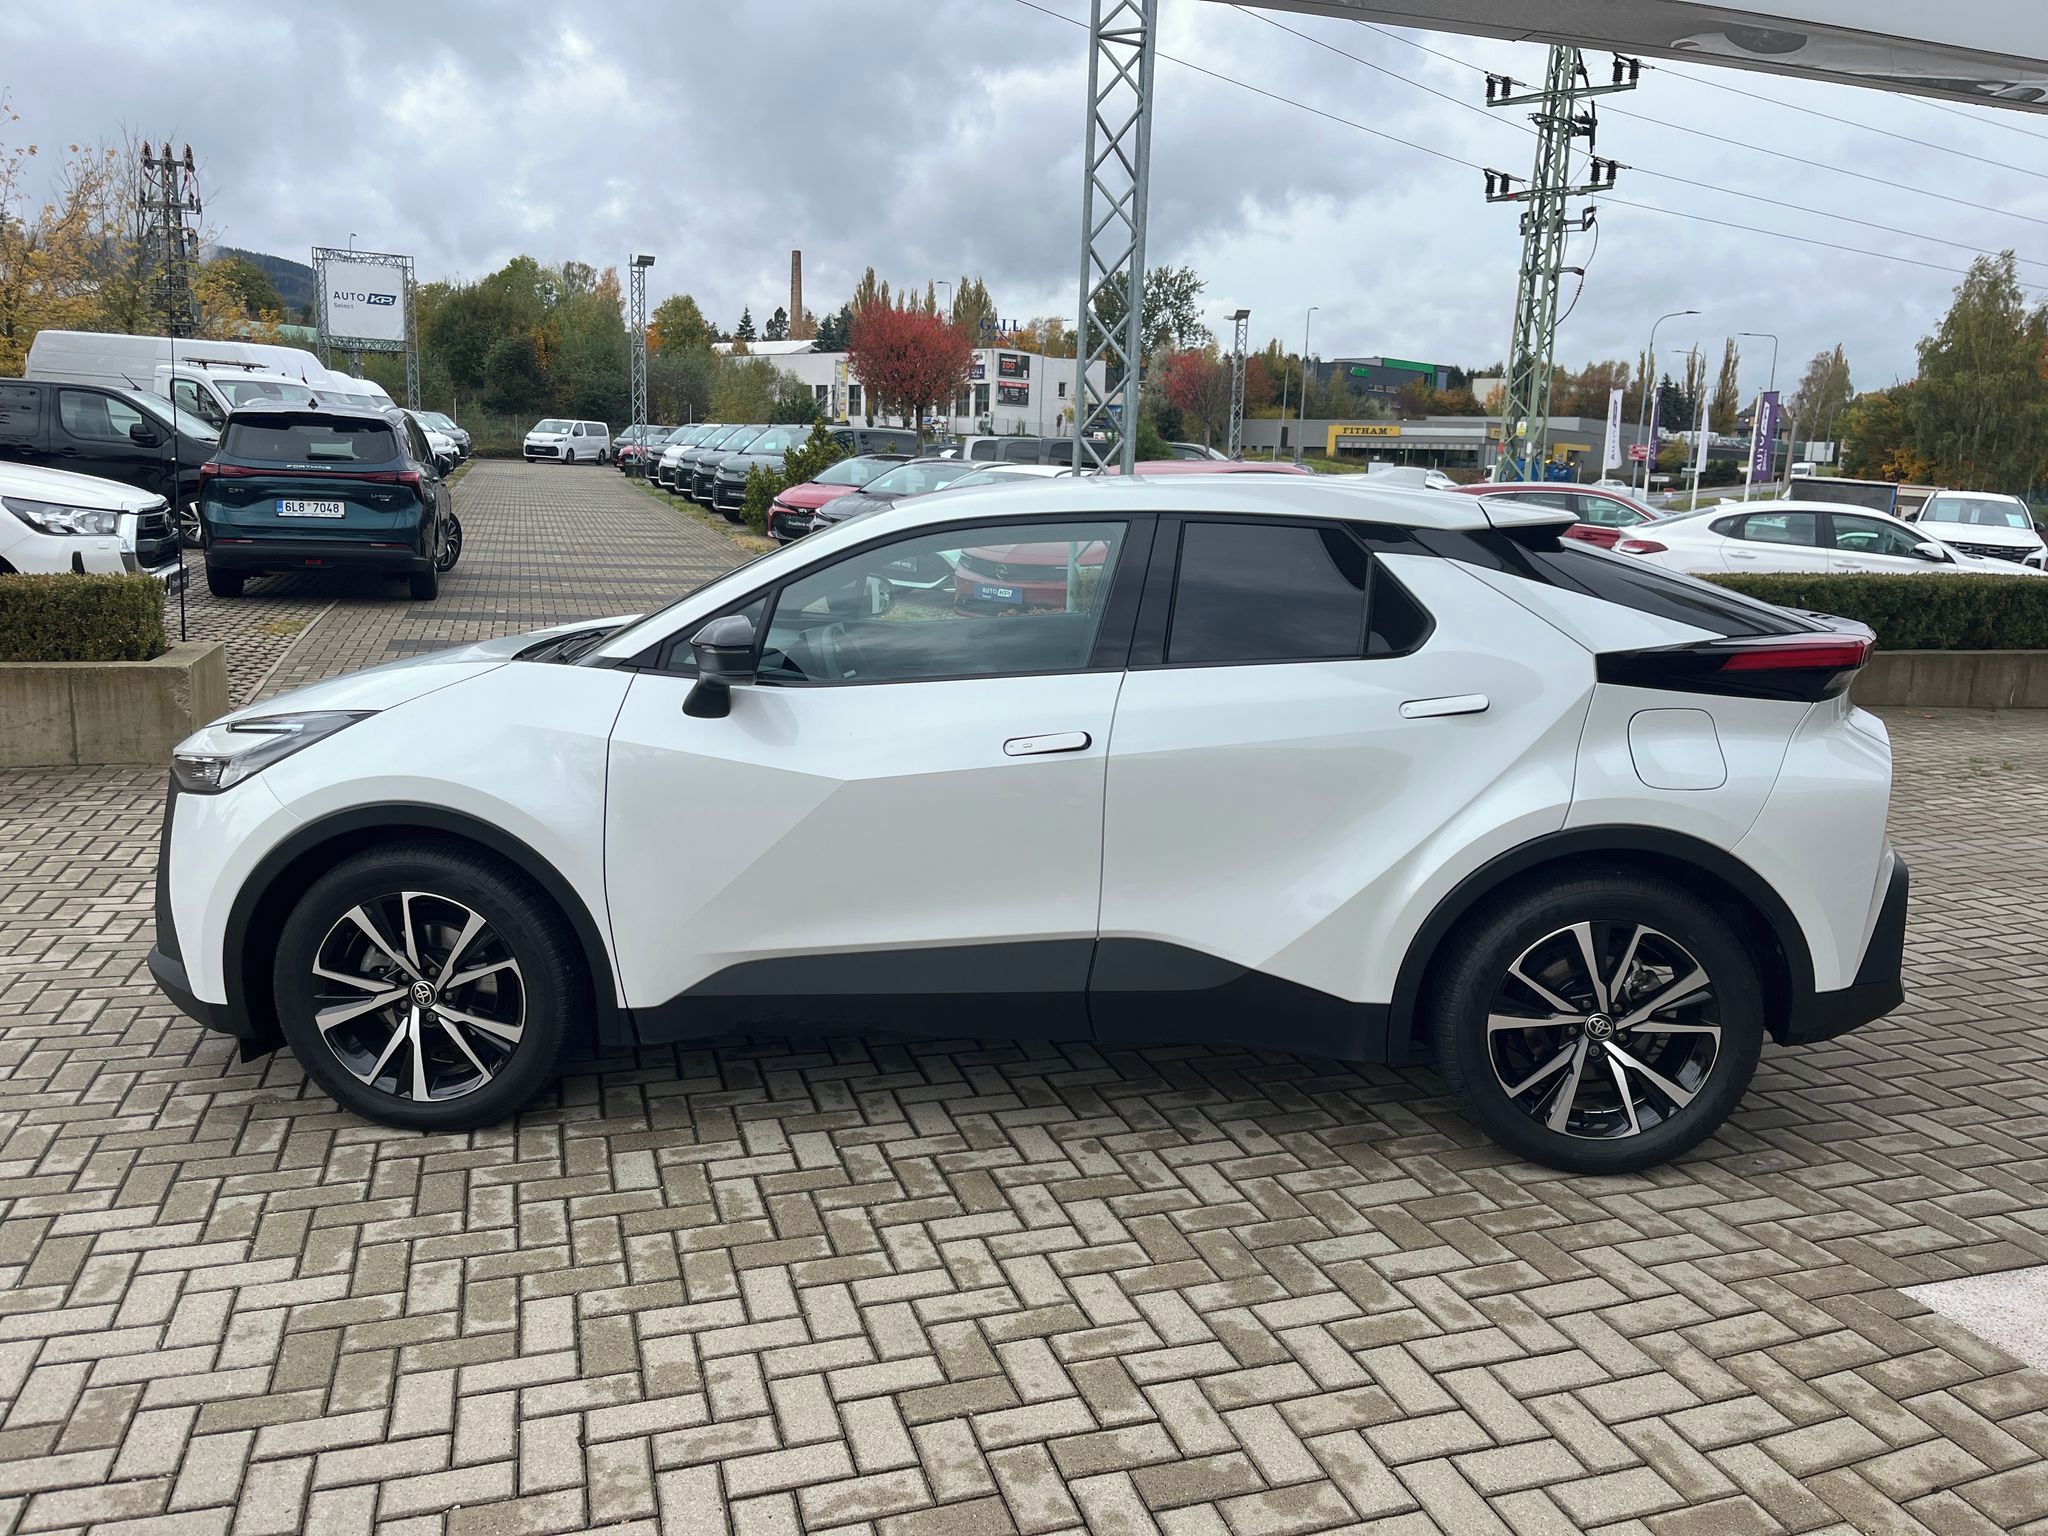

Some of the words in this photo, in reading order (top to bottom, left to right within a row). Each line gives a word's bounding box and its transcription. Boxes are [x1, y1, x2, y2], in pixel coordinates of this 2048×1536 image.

[333, 291, 365, 302] AUTO
[1342, 426, 1388, 435] FITHAM
[285, 502, 305, 512] 6L8
[313, 502, 339, 513] 7048
